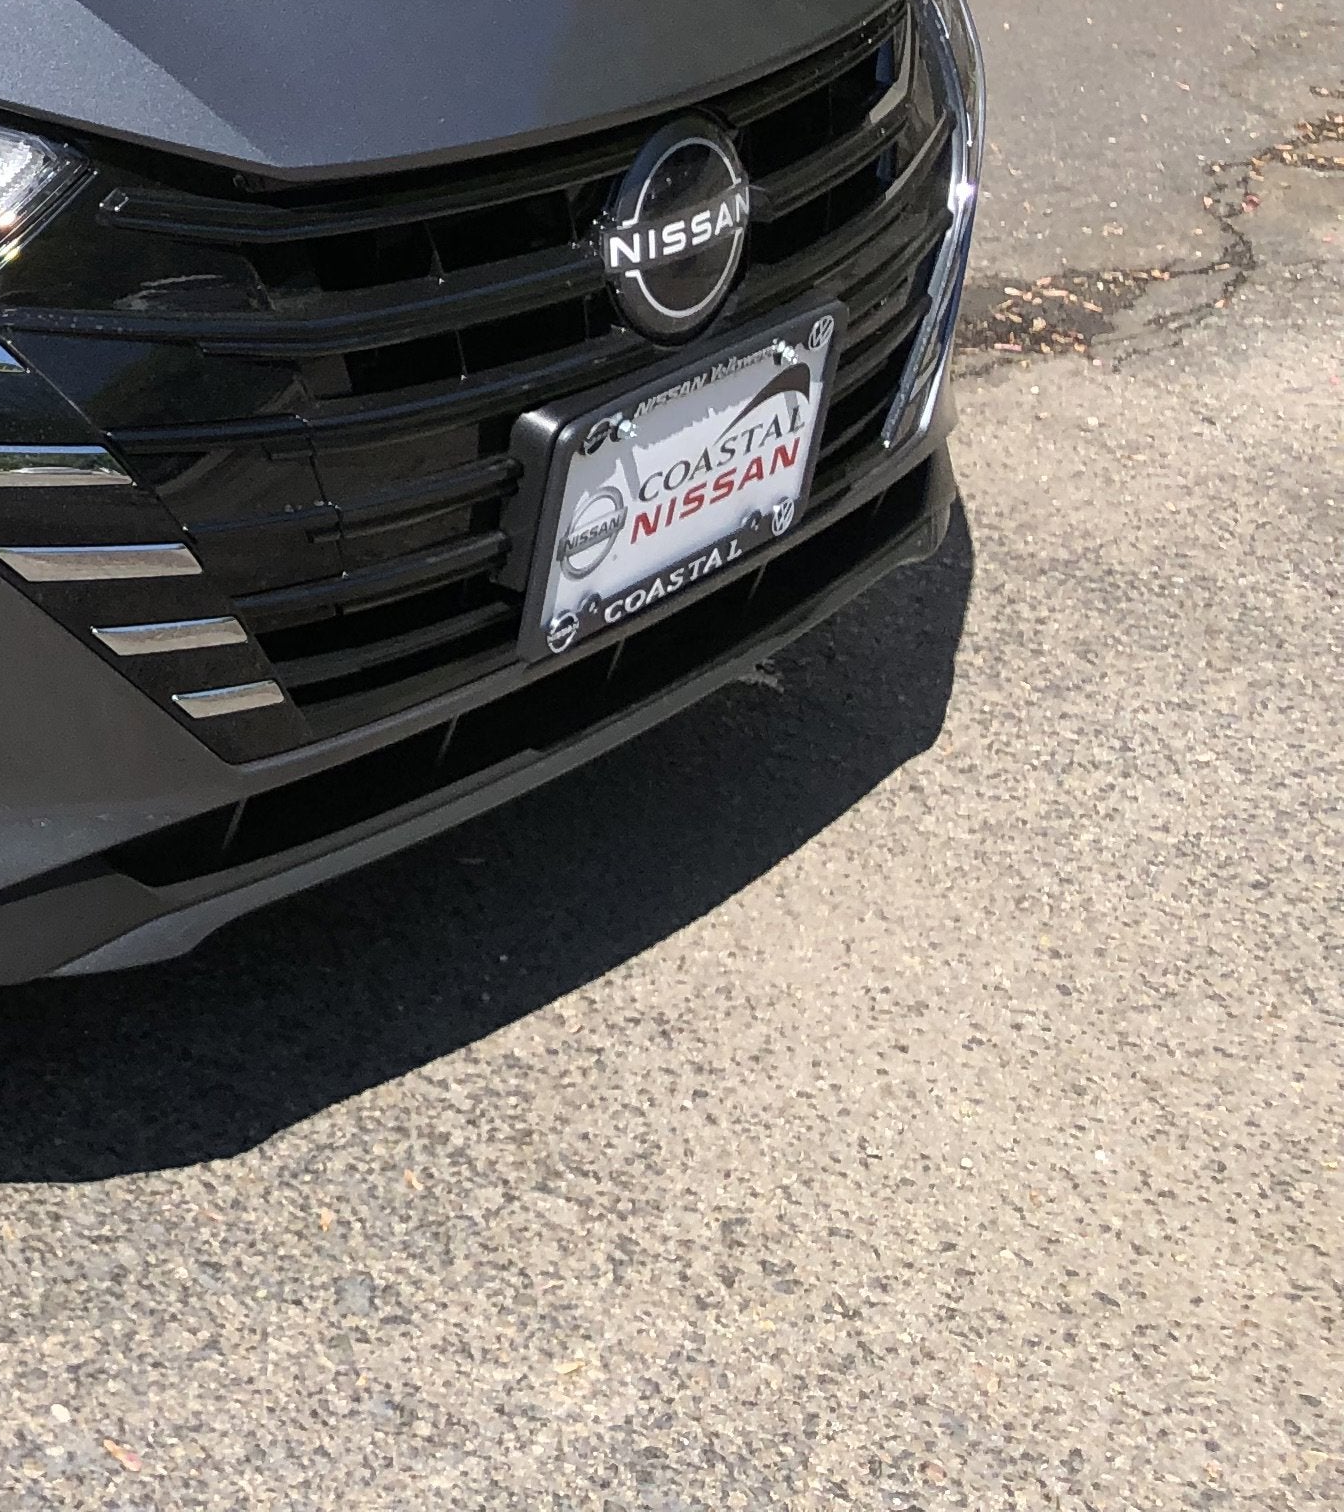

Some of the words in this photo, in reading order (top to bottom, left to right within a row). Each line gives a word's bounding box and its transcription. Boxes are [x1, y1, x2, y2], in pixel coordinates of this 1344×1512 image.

[608, 186, 750, 268] NISSAN
[630, 436, 801, 545] NISSAN
[638, 404, 806, 502] COASTAL
[564, 514, 621, 551] NISSAN
[604, 538, 742, 623] COASTAL
